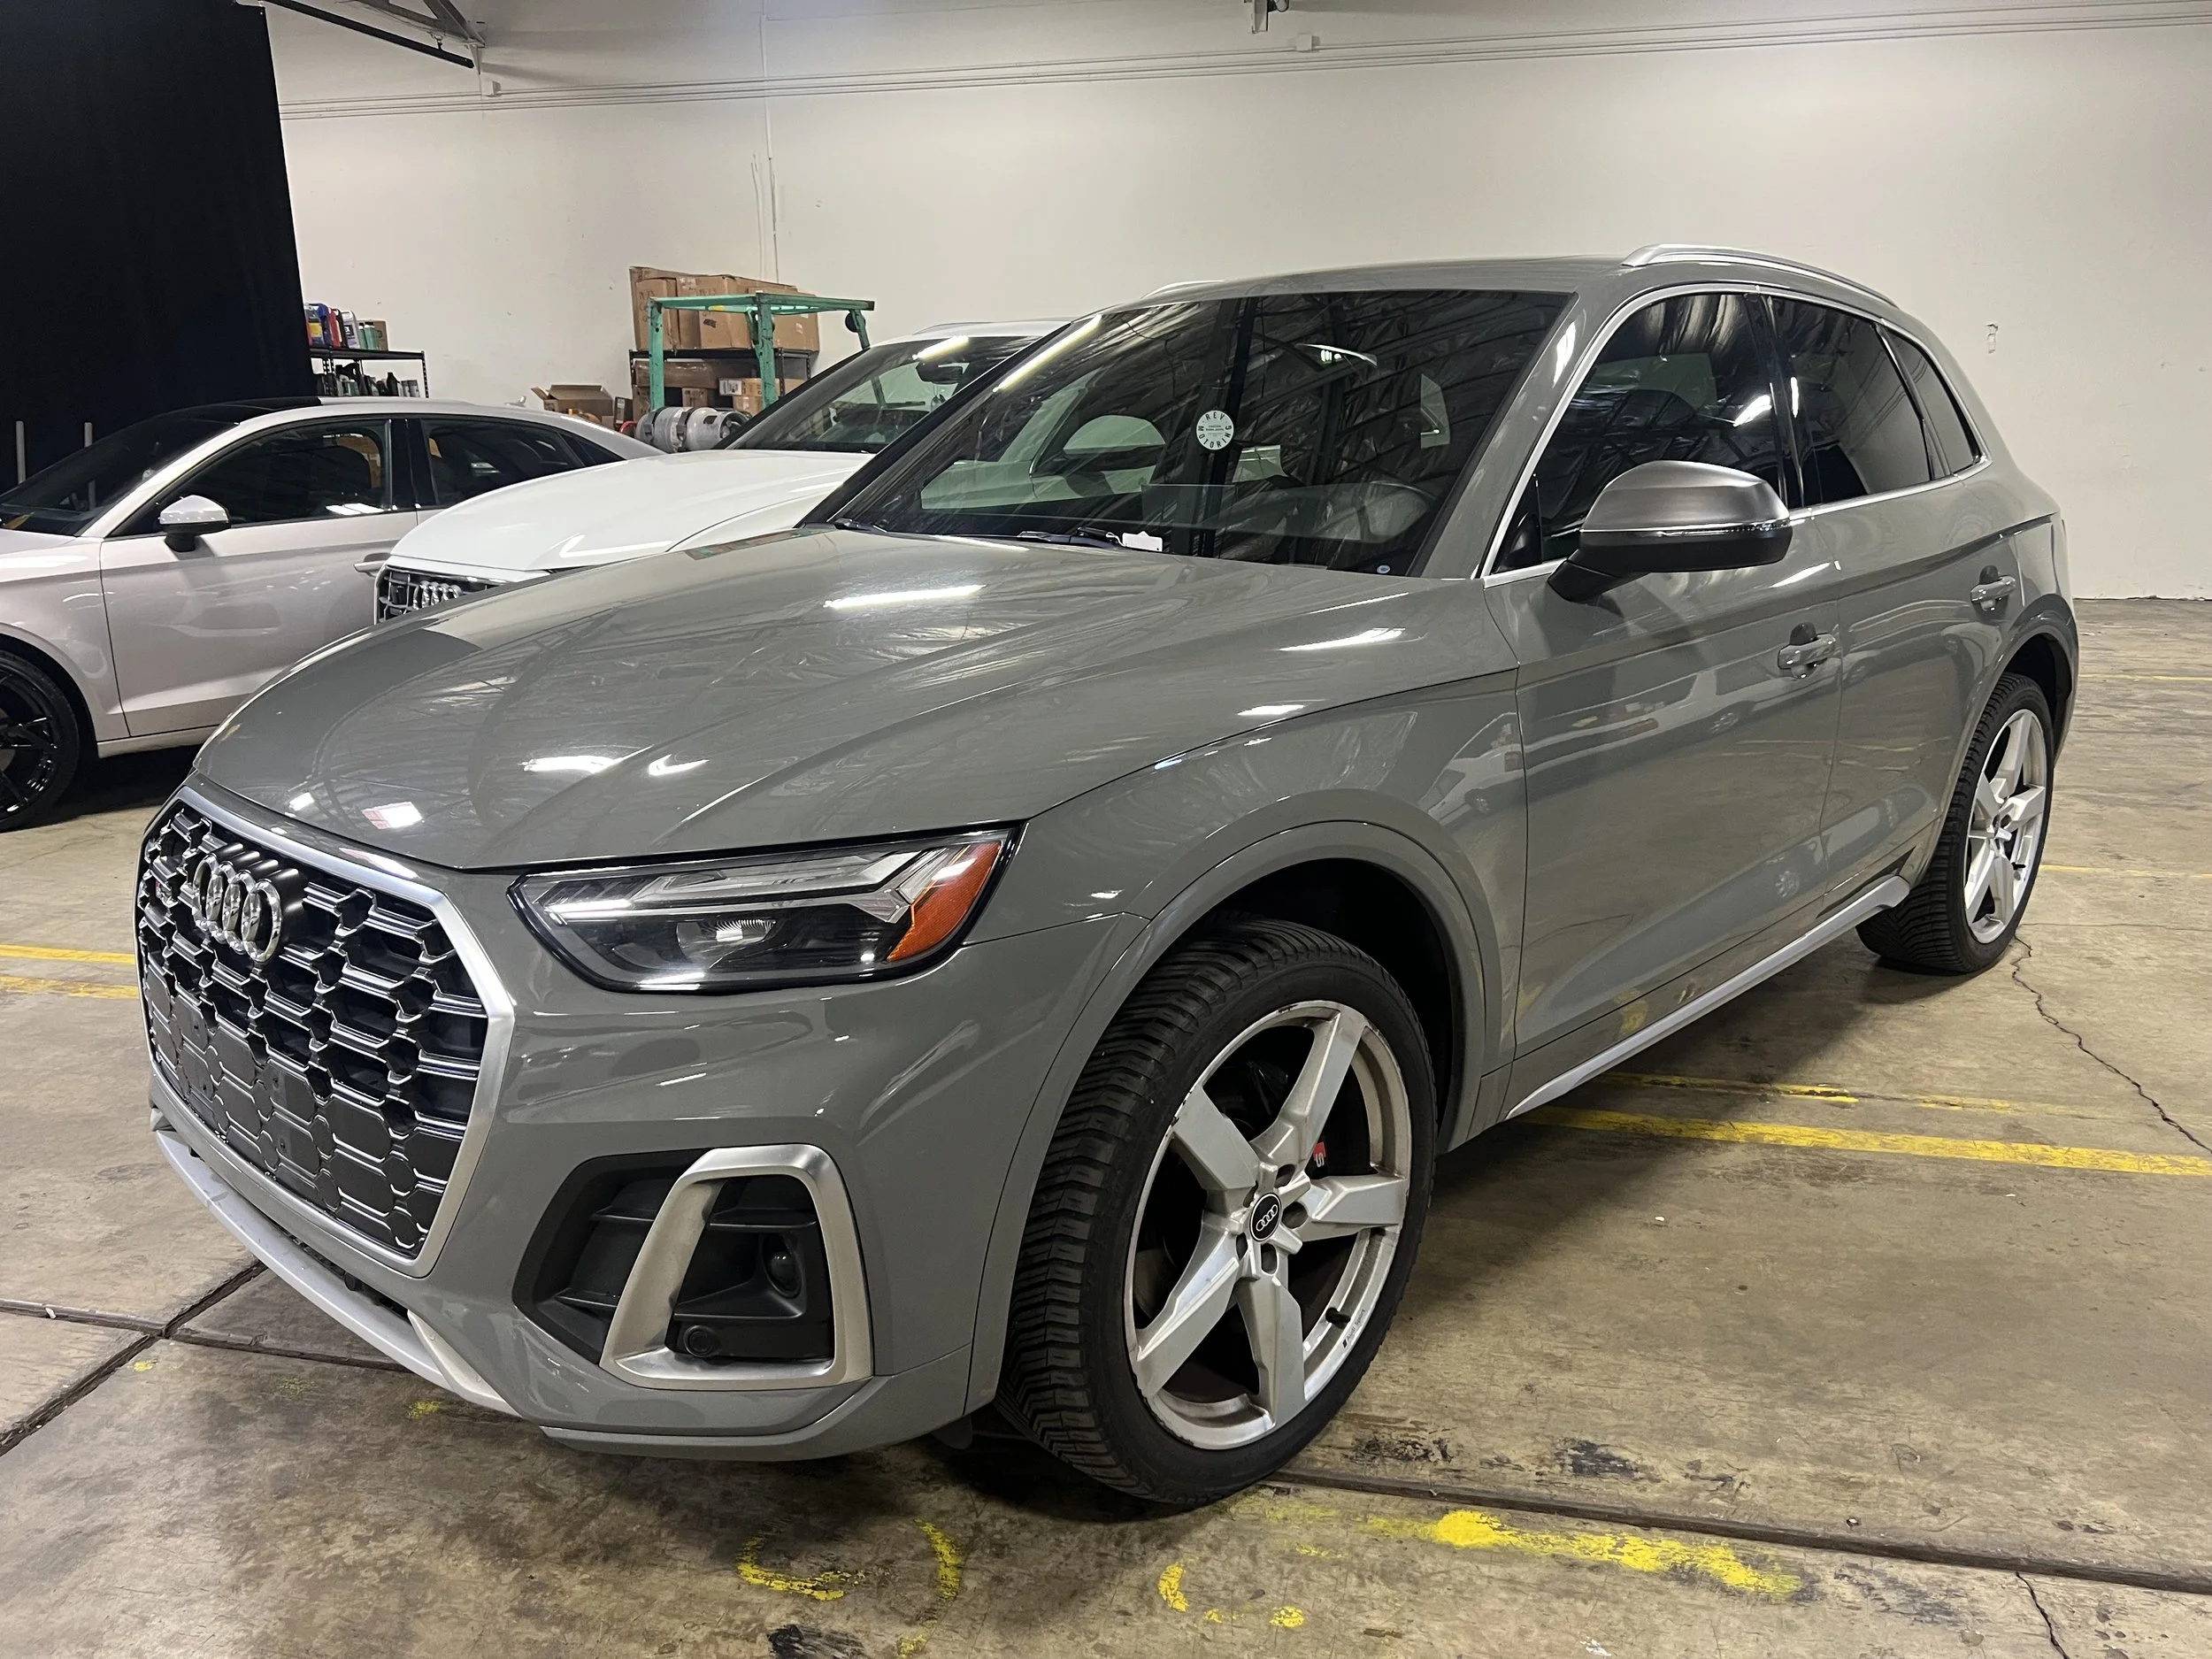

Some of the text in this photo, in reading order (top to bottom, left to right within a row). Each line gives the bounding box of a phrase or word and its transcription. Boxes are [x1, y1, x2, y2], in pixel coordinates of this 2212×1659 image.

[1205, 411, 1225, 421] REV
[1198, 425, 1232, 449] MOTORING
[1346, 1309, 1366, 1340] Audi Sport
